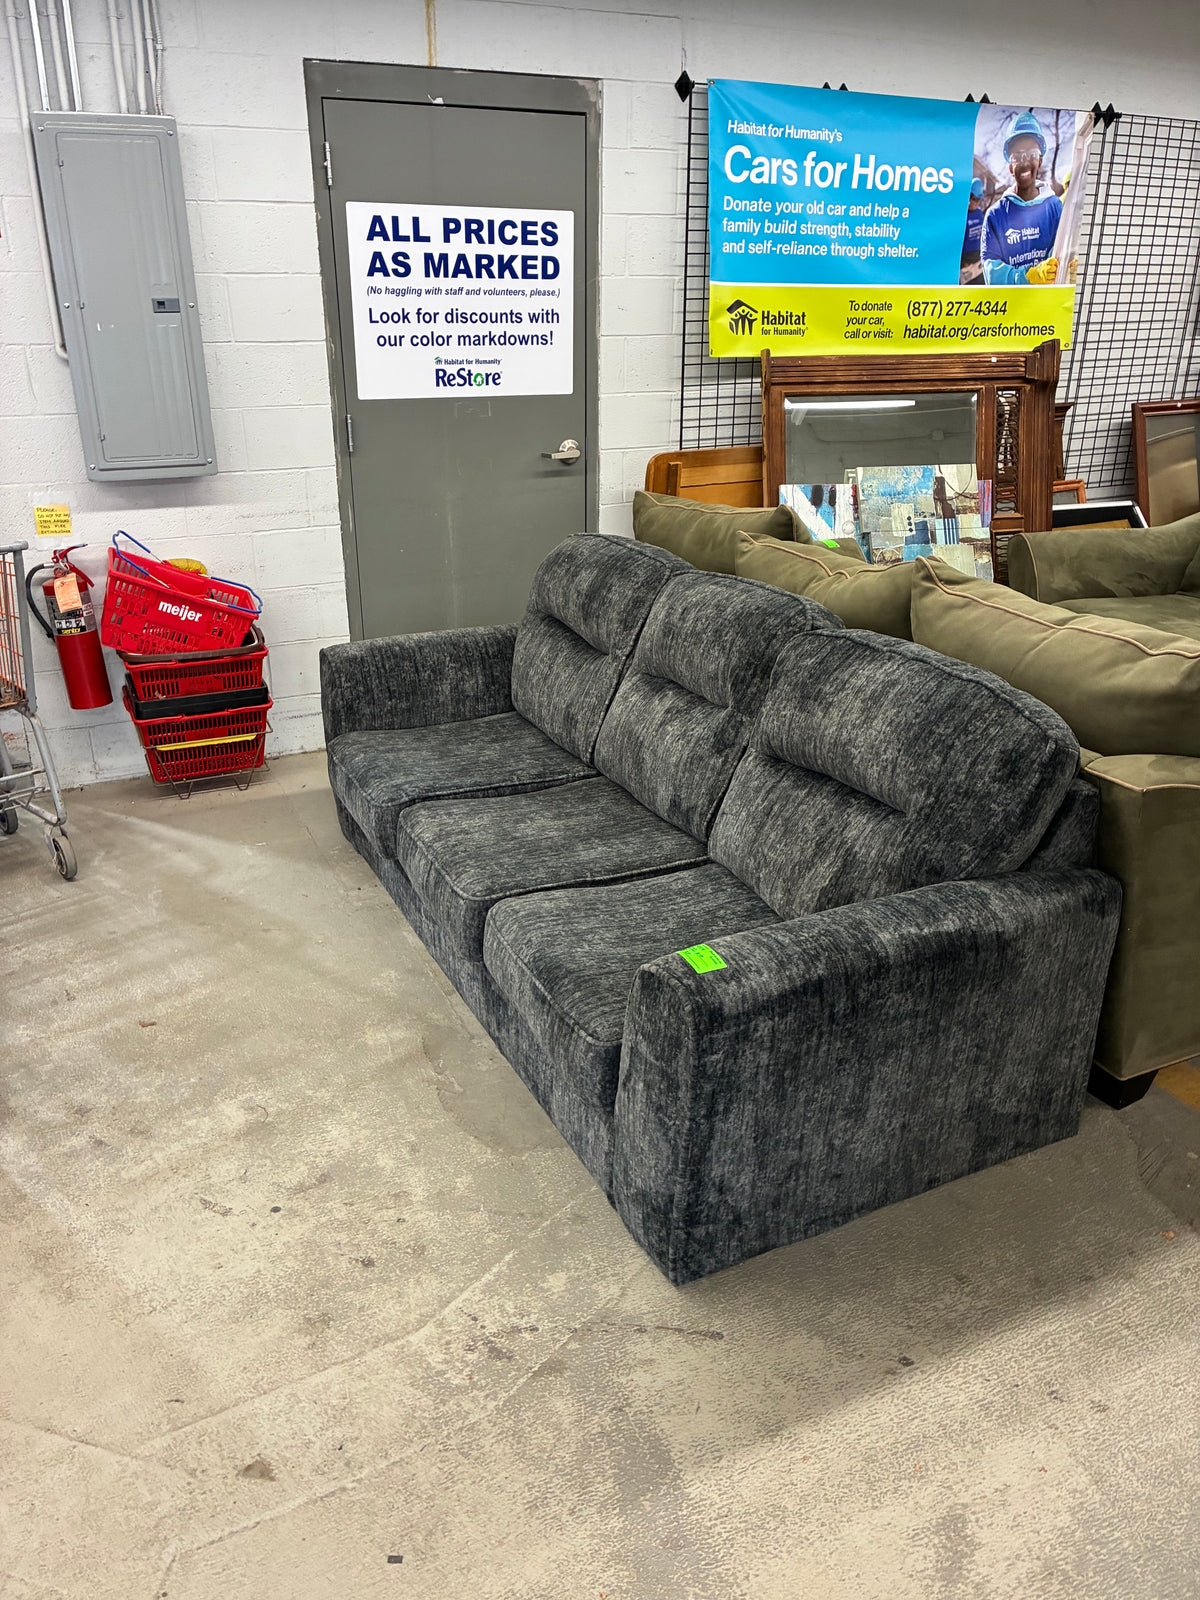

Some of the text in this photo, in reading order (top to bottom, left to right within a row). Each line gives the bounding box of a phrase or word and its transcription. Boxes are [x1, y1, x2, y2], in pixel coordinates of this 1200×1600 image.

[727, 120, 842, 144] Habitat for Humanity's
[724, 145, 954, 194] Cars for Homes
[723, 196, 909, 219] Donate your old car and help a
[366, 215, 559, 246] ALL PRICES
[723, 218, 900, 241] family build strength, stability
[722, 240, 919, 260] and self-reliance through shelter.
[367, 251, 560, 280] AS MARKED
[366, 286, 560, 298] (No haggling with staff and volunteers, please.)
[849, 300, 892, 311] To donate
[907, 300, 1008, 319] (877) 277-4344
[368, 307, 560, 324] Look for discounts with
[761, 310, 806, 325] Habitat
[846, 316, 885, 327] your car,
[376, 331, 553, 347] our color markdowns!
[761, 327, 805, 337] for Humanity
[844, 328, 893, 339] call or visit:
[902, 322, 1055, 340] habitat.org/carsforhomes
[435, 368, 501, 387] ReStore
[158, 601, 202, 622] meijer
